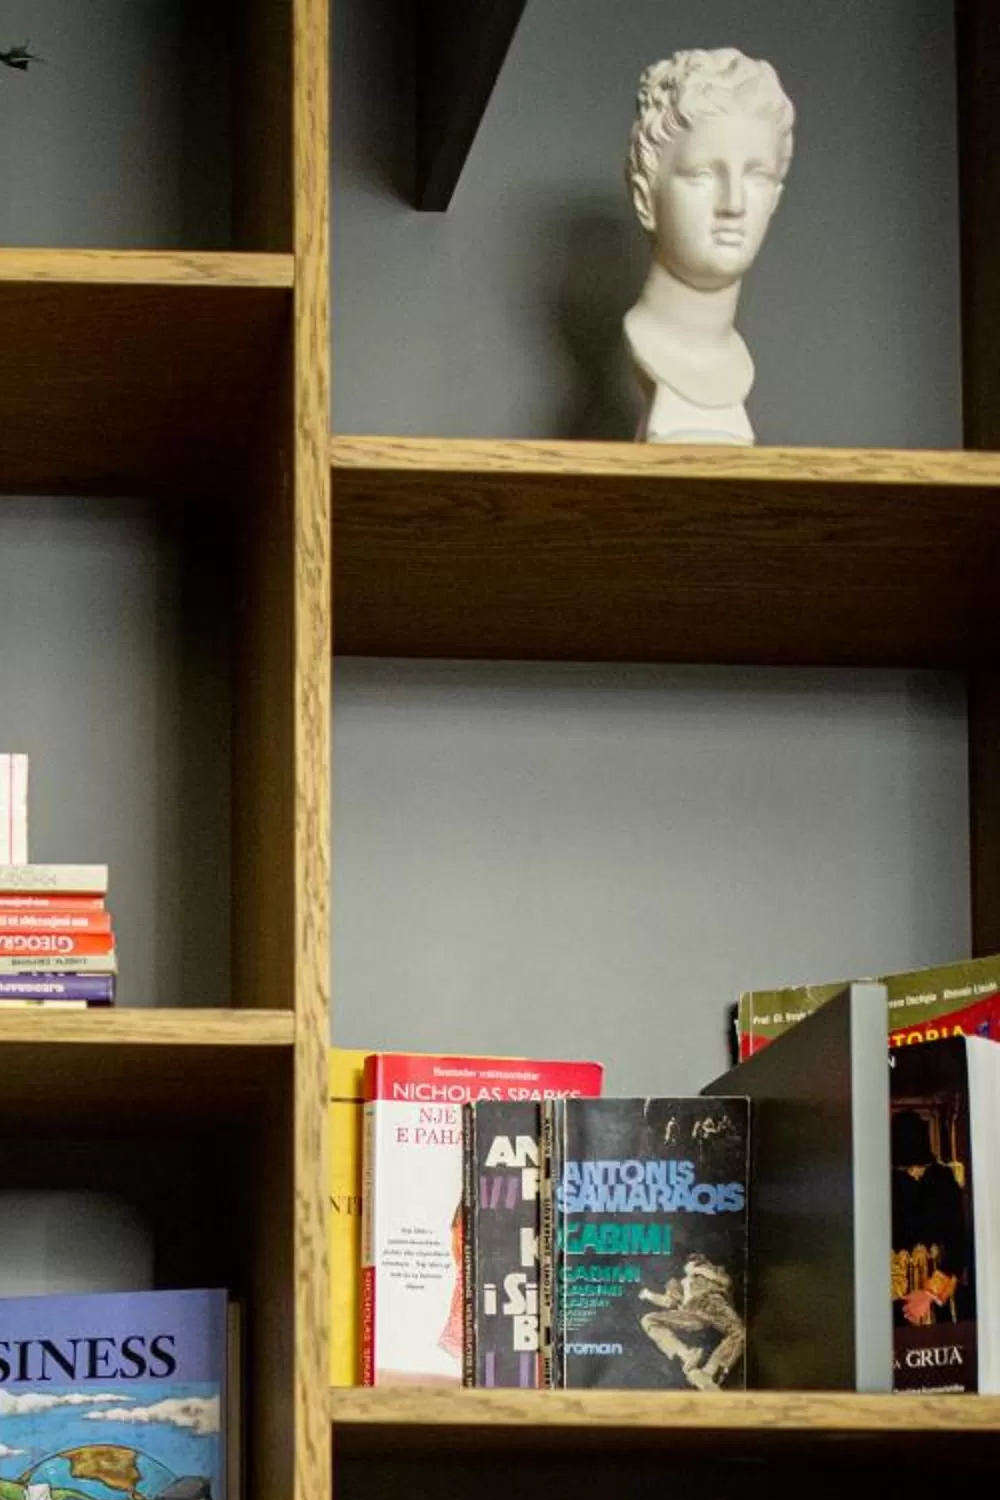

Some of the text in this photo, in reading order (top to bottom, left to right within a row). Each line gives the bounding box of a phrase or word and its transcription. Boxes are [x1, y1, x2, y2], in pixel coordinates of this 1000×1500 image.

[889, 1025, 964, 1048] TORIA
[393, 1083, 501, 1101] NICHOLAS
[396, 1127, 409, 1142] E
[562, 1160, 695, 1186] ANTONIS
[556, 1183, 745, 1213] SAMARAQIS
[563, 1342, 623, 1355] roman
[905, 1345, 964, 1368] GRUA
